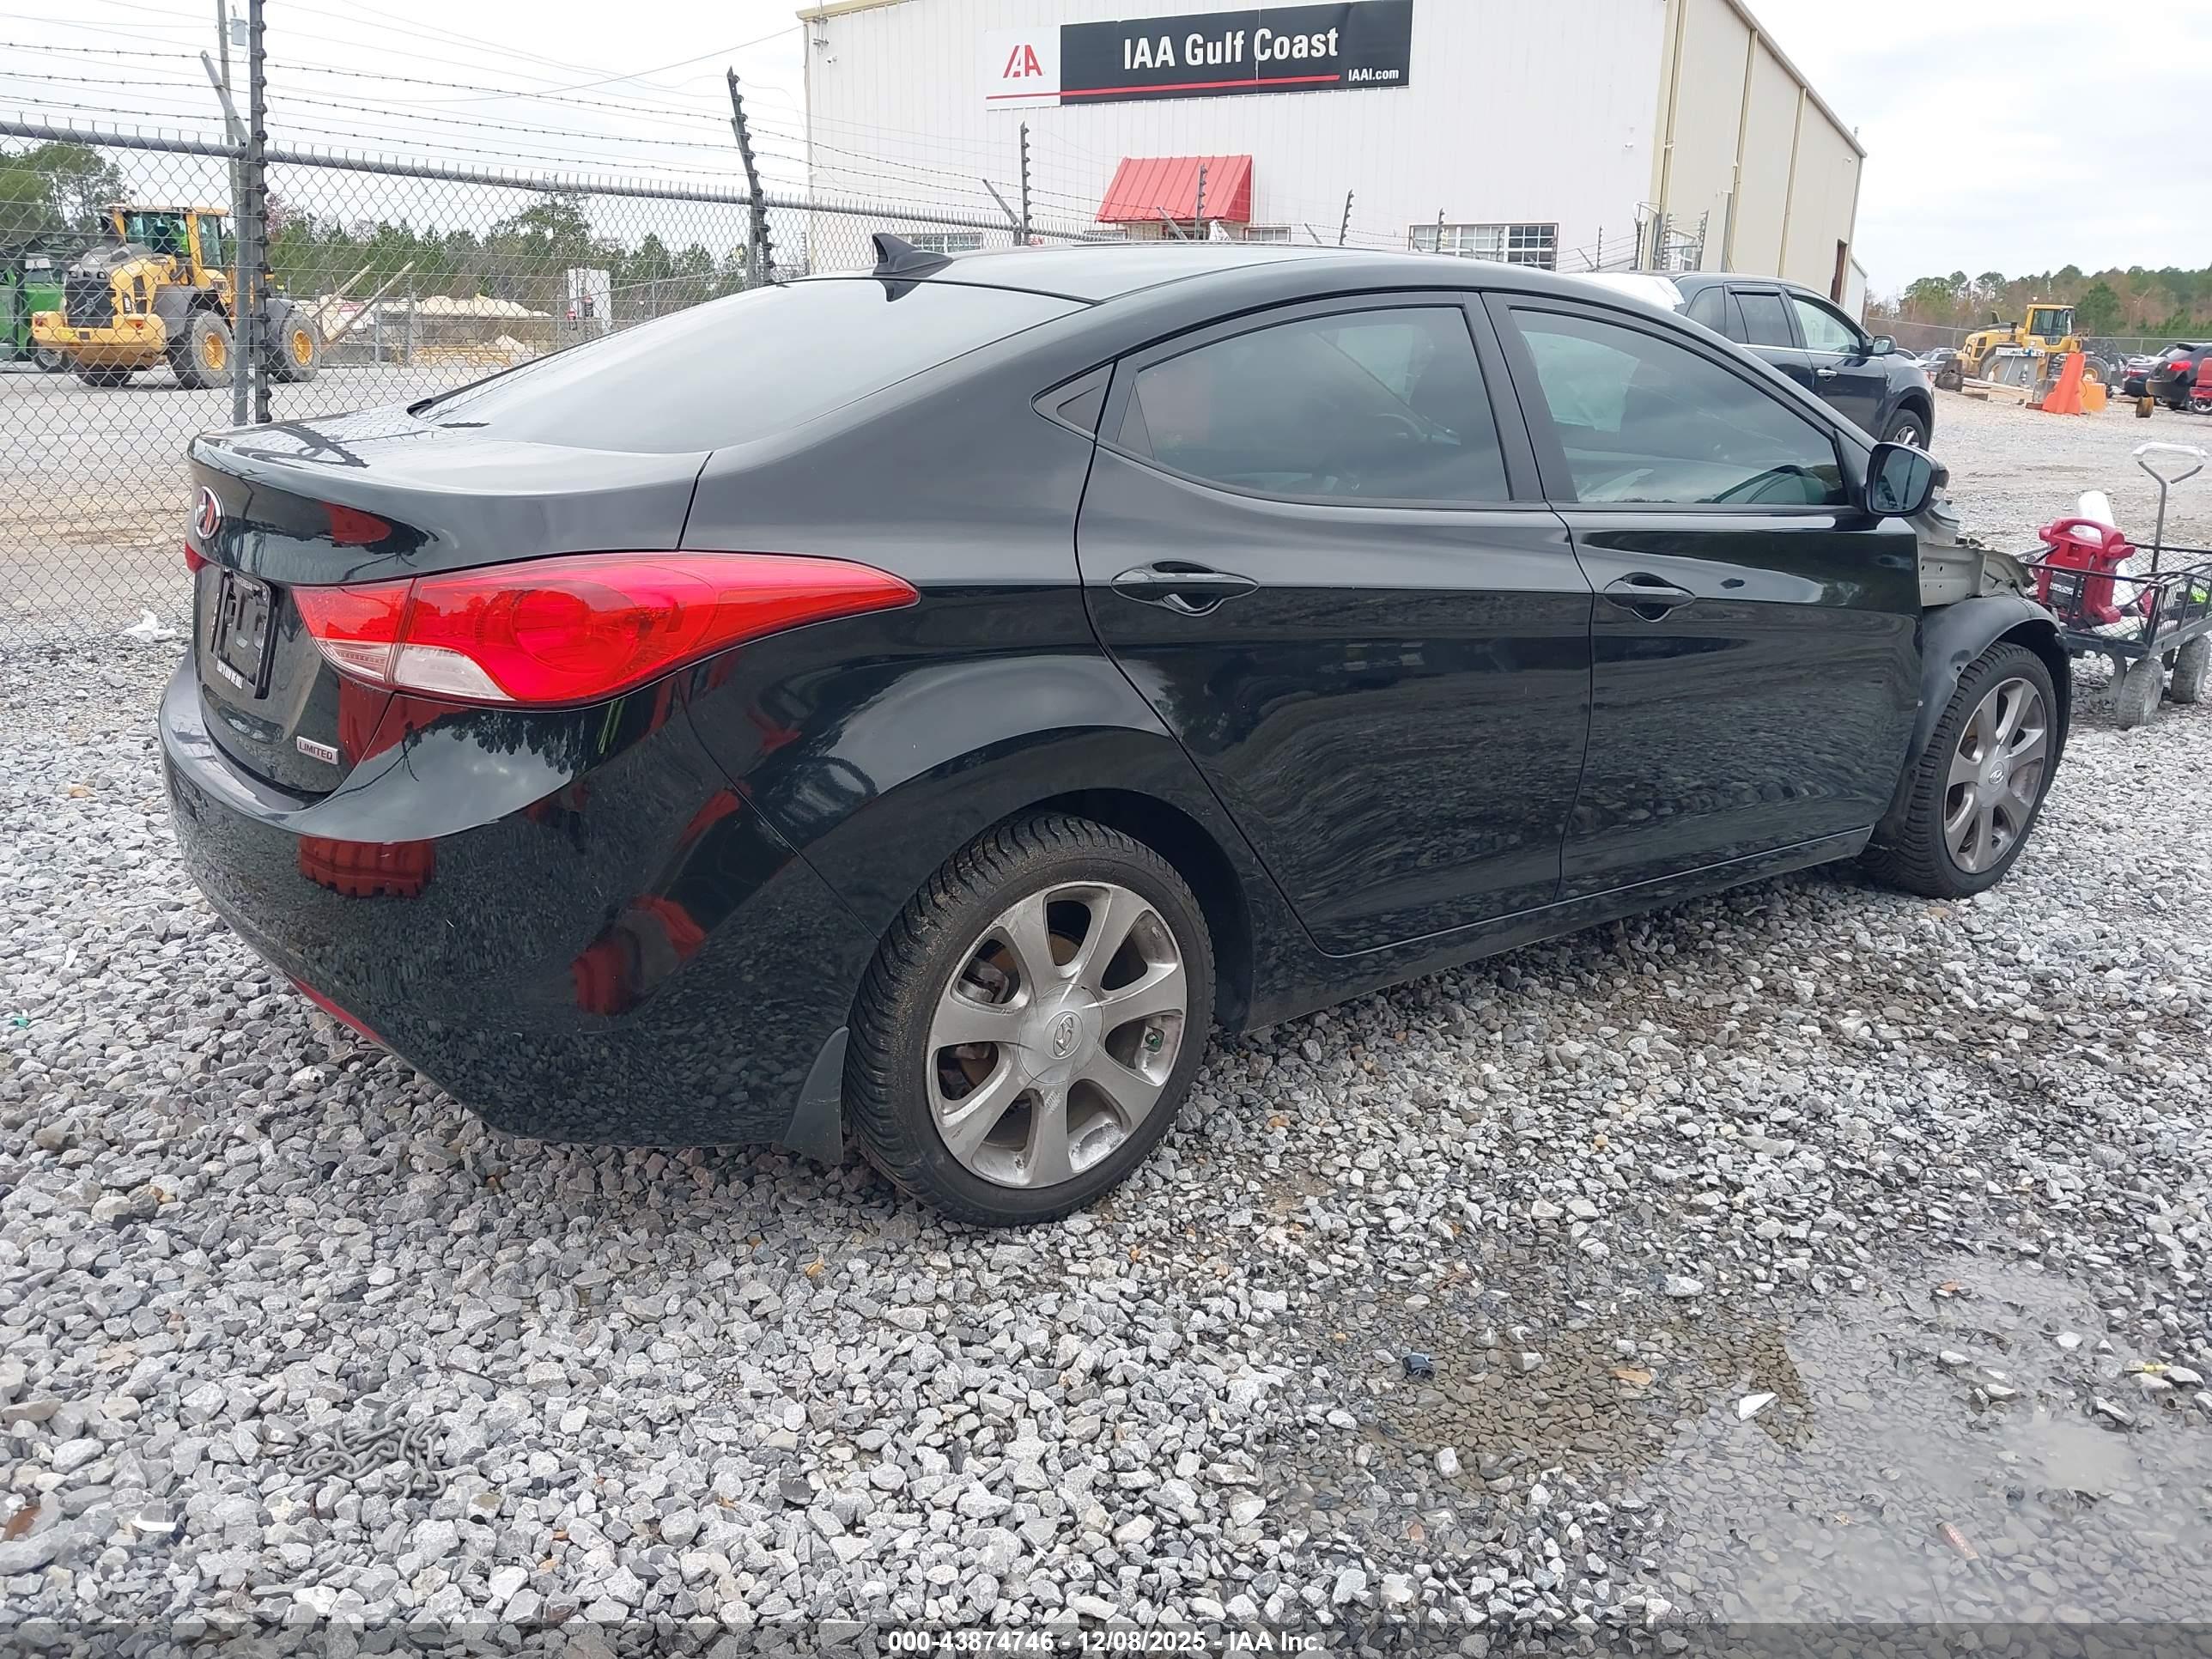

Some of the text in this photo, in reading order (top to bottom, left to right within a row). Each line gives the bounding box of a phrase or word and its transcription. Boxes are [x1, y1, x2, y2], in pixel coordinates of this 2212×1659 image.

[1124, 27, 1339, 70] IAA Gulf Coast
[1348, 68, 1399, 82] IAAI.com
[299, 741, 333, 760] LIMITED
